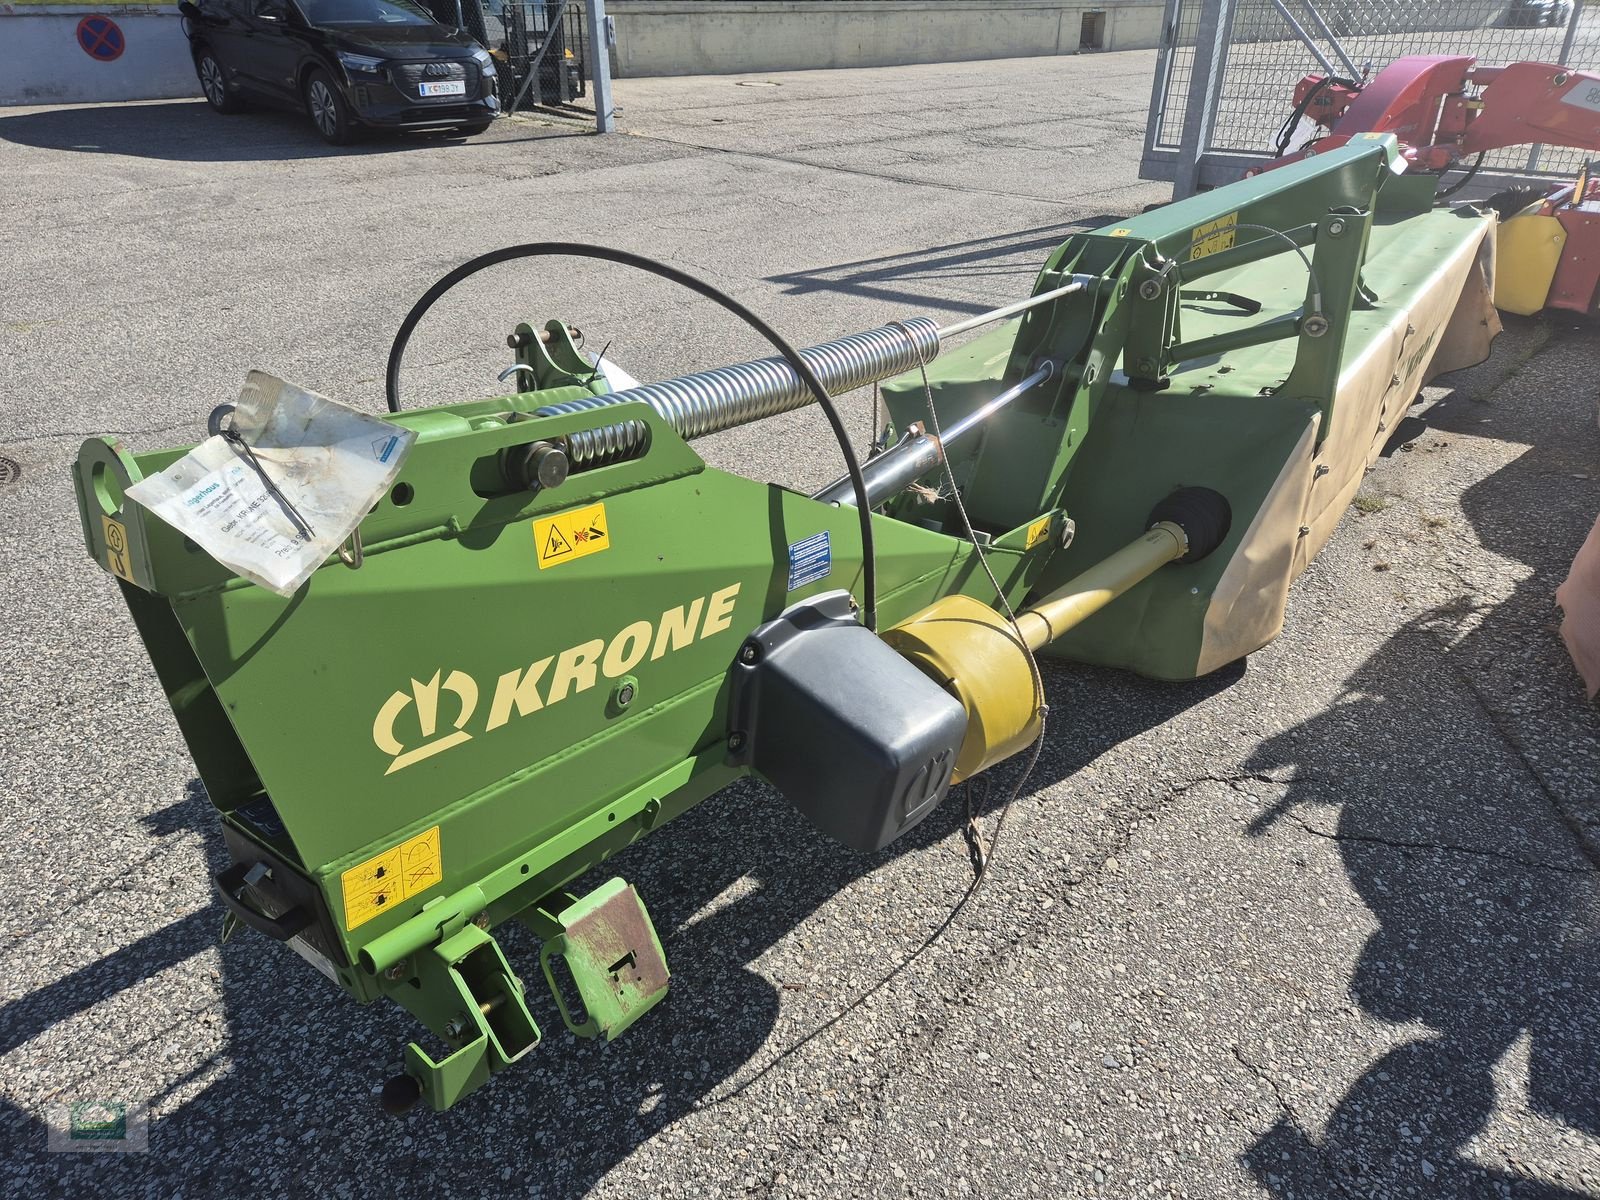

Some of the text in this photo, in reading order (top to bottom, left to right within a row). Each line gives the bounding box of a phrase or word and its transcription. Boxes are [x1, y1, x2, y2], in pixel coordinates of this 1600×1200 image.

[184, 482, 220, 505] agerhaus
[236, 500, 261, 519] KRNE
[485, 582, 741, 732] KRONE
